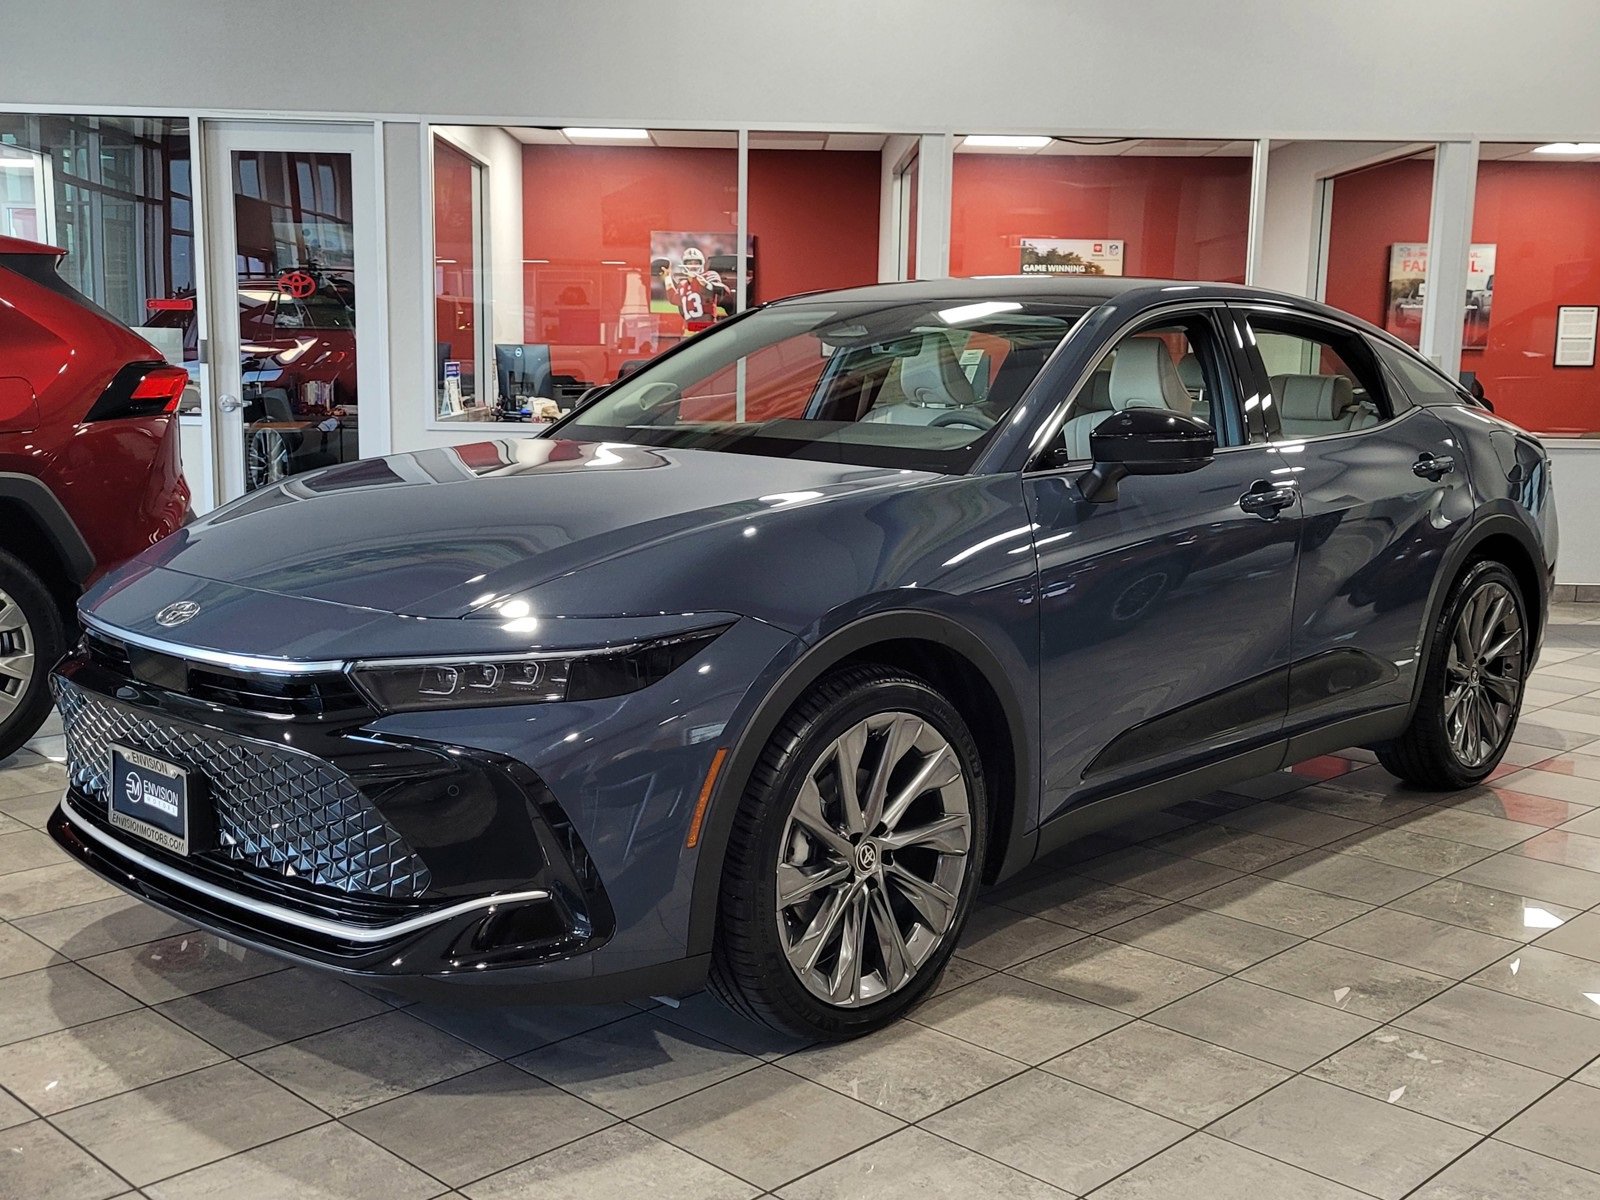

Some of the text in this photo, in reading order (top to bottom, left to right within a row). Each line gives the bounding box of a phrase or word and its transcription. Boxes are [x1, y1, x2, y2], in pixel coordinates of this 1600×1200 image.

[1023, 264, 1086, 273] GAME WINNING
[681, 293, 704, 321] 13
[131, 752, 168, 774] ENVISION
[143, 780, 178, 806] ENVISION
[111, 814, 186, 853] ENVISIONMOTORS.COM
